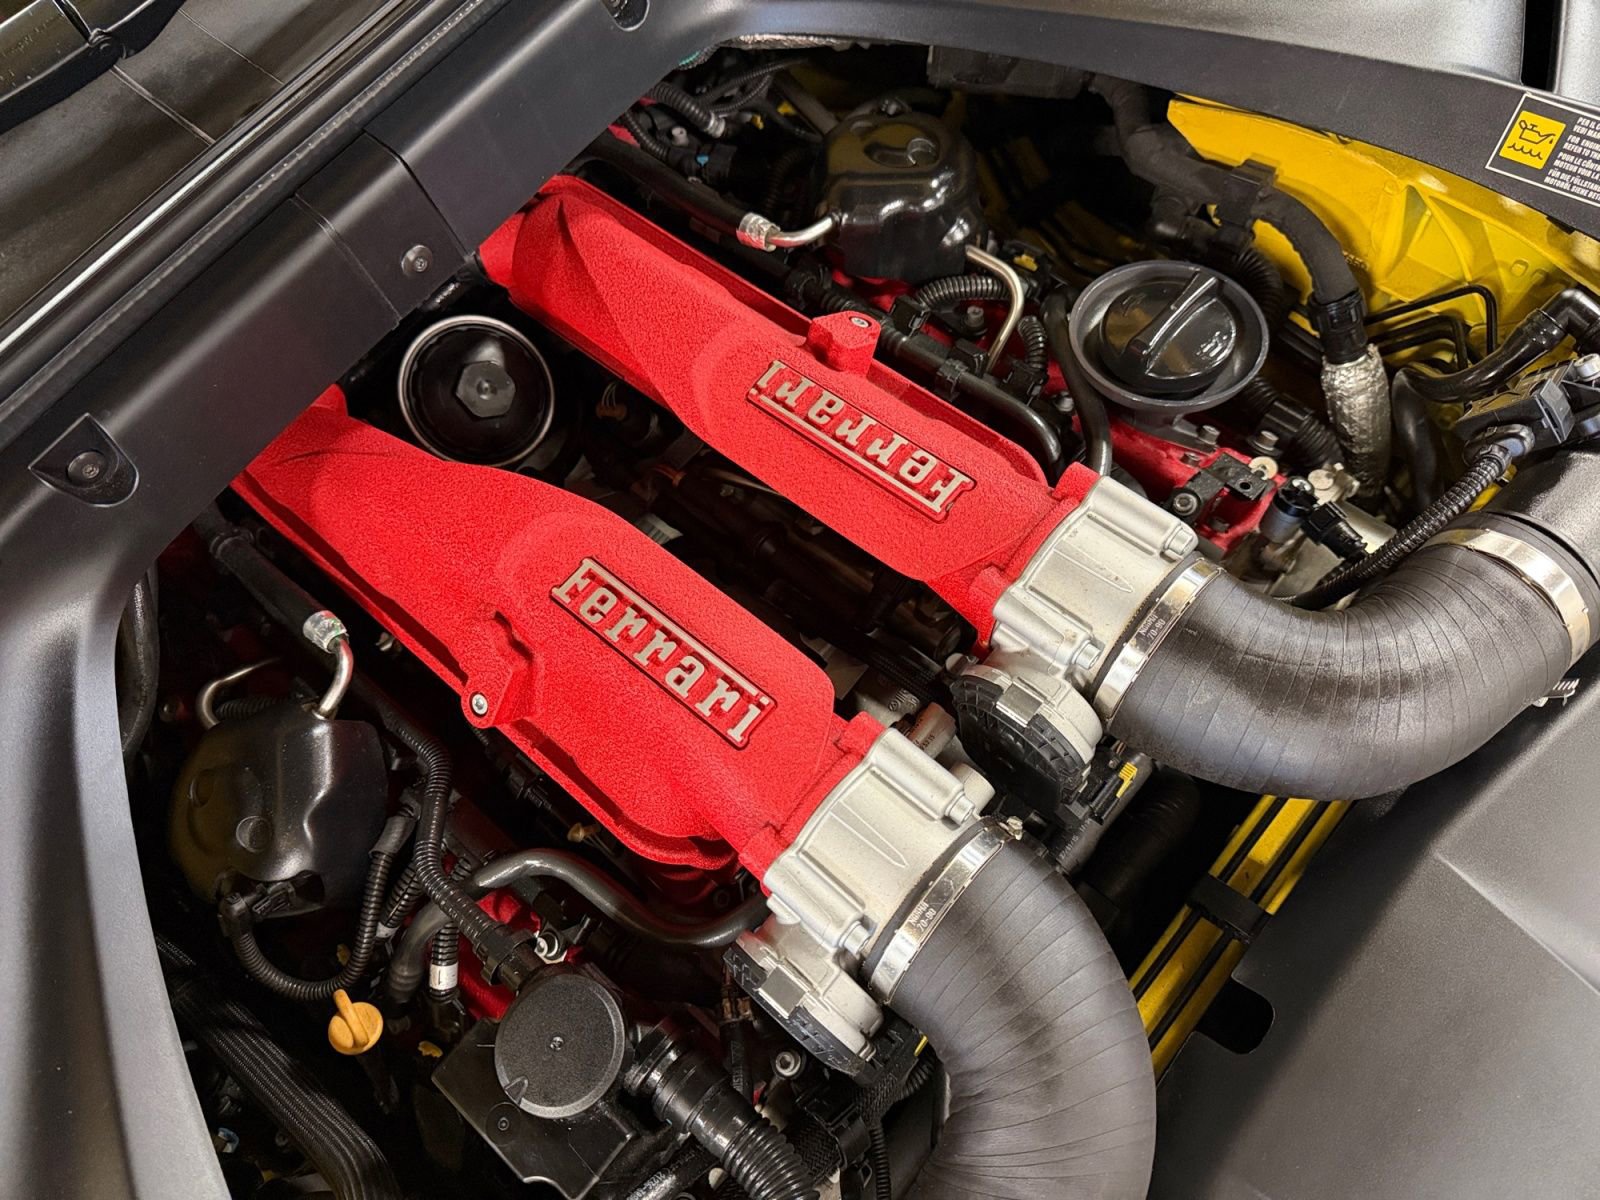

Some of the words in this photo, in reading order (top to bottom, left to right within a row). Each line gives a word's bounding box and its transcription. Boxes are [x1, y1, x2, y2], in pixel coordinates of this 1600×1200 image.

[1573, 124, 1588, 135] VEDI
[1577, 117, 1590, 127] PER
[1567, 134, 1581, 145] FOR
[1557, 152, 1575, 163] POUR
[1563, 142, 1583, 154] REFER
[1582, 148, 1591, 157] TO
[1548, 168, 1561, 178] FÜR
[1560, 173, 1571, 181] DIE
[1553, 160, 1578, 173] MOTEUR
[1577, 167, 1592, 177] VOIR
[1544, 176, 1571, 190] MOTORÖL
[1571, 185, 1589, 197] SIEHE
[750, 361, 971, 512] Ferrari
[1147, 618, 1166, 640] 70-90
[552, 559, 770, 742] Ferrari
[917, 908, 937, 932] 70-90
